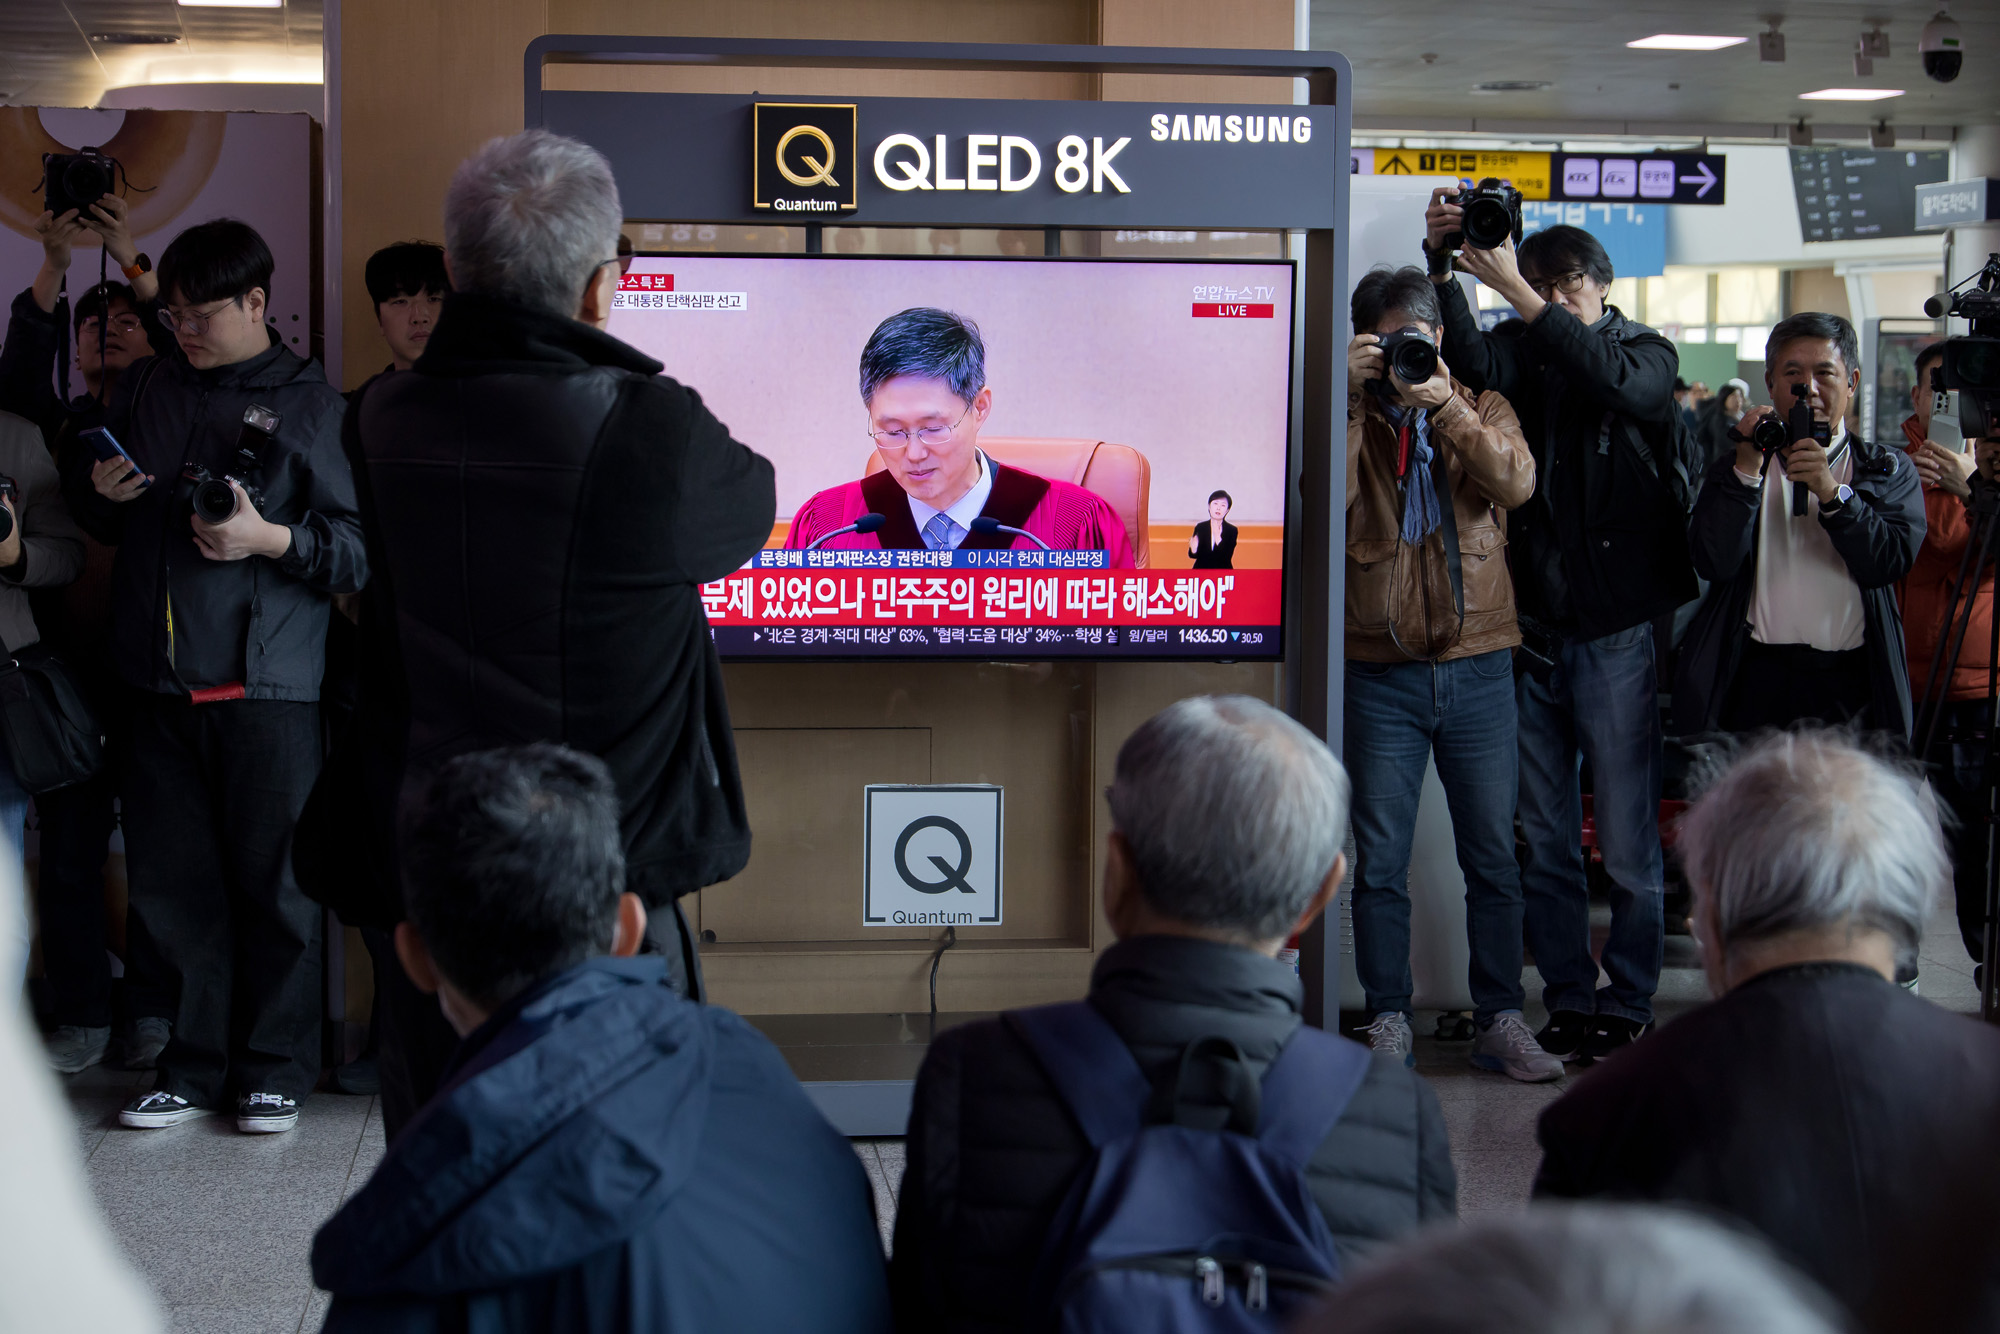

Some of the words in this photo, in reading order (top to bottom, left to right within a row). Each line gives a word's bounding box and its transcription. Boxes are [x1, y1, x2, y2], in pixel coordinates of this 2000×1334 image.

[1150, 113, 1312, 143] SAMSUNG
[776, 124, 840, 187] Q
[873, 133, 1042, 192] QLED
[1054, 134, 1132, 193] 8K
[774, 198, 837, 212] Quantum
[613, 293, 626, 308] 윤
[627, 293, 664, 308] 대통령
[666, 294, 715, 308] 탄핵심판
[717, 295, 741, 308] 선고
[1192, 285, 1275, 301] 연합뉴스TV
[1218, 305, 1247, 316] LIVE
[760, 550, 802, 567] 문형배
[807, 550, 893, 567] 헌법재판소장
[896, 550, 953, 567] 권한대행
[967, 550, 981, 566] 이
[985, 550, 1014, 567] 시각
[1017, 550, 1046, 567] 헌재
[1049, 550, 1104, 567] 대심판정
[701, 577, 754, 619] 문제
[760, 577, 866, 619] 있었으나
[872, 576, 975, 619] 민주주의
[981, 576, 1059, 619] 원리에
[1066, 577, 1118, 619] 따라
[1122, 575, 1235, 619] 해소해야"
[800, 627, 860, 644] 경계·적대
[864, 627, 897, 644] 대상"
[899, 628, 930, 645] 63%,
[933, 626, 998, 644] "협력·도움
[1000, 627, 1034, 644] 대상"
[1128, 628, 1169, 644] 원/달러
[1178, 627, 1228, 644] 1436.50
[893, 815, 978, 895] Q
[892, 909, 973, 924] Quantum
